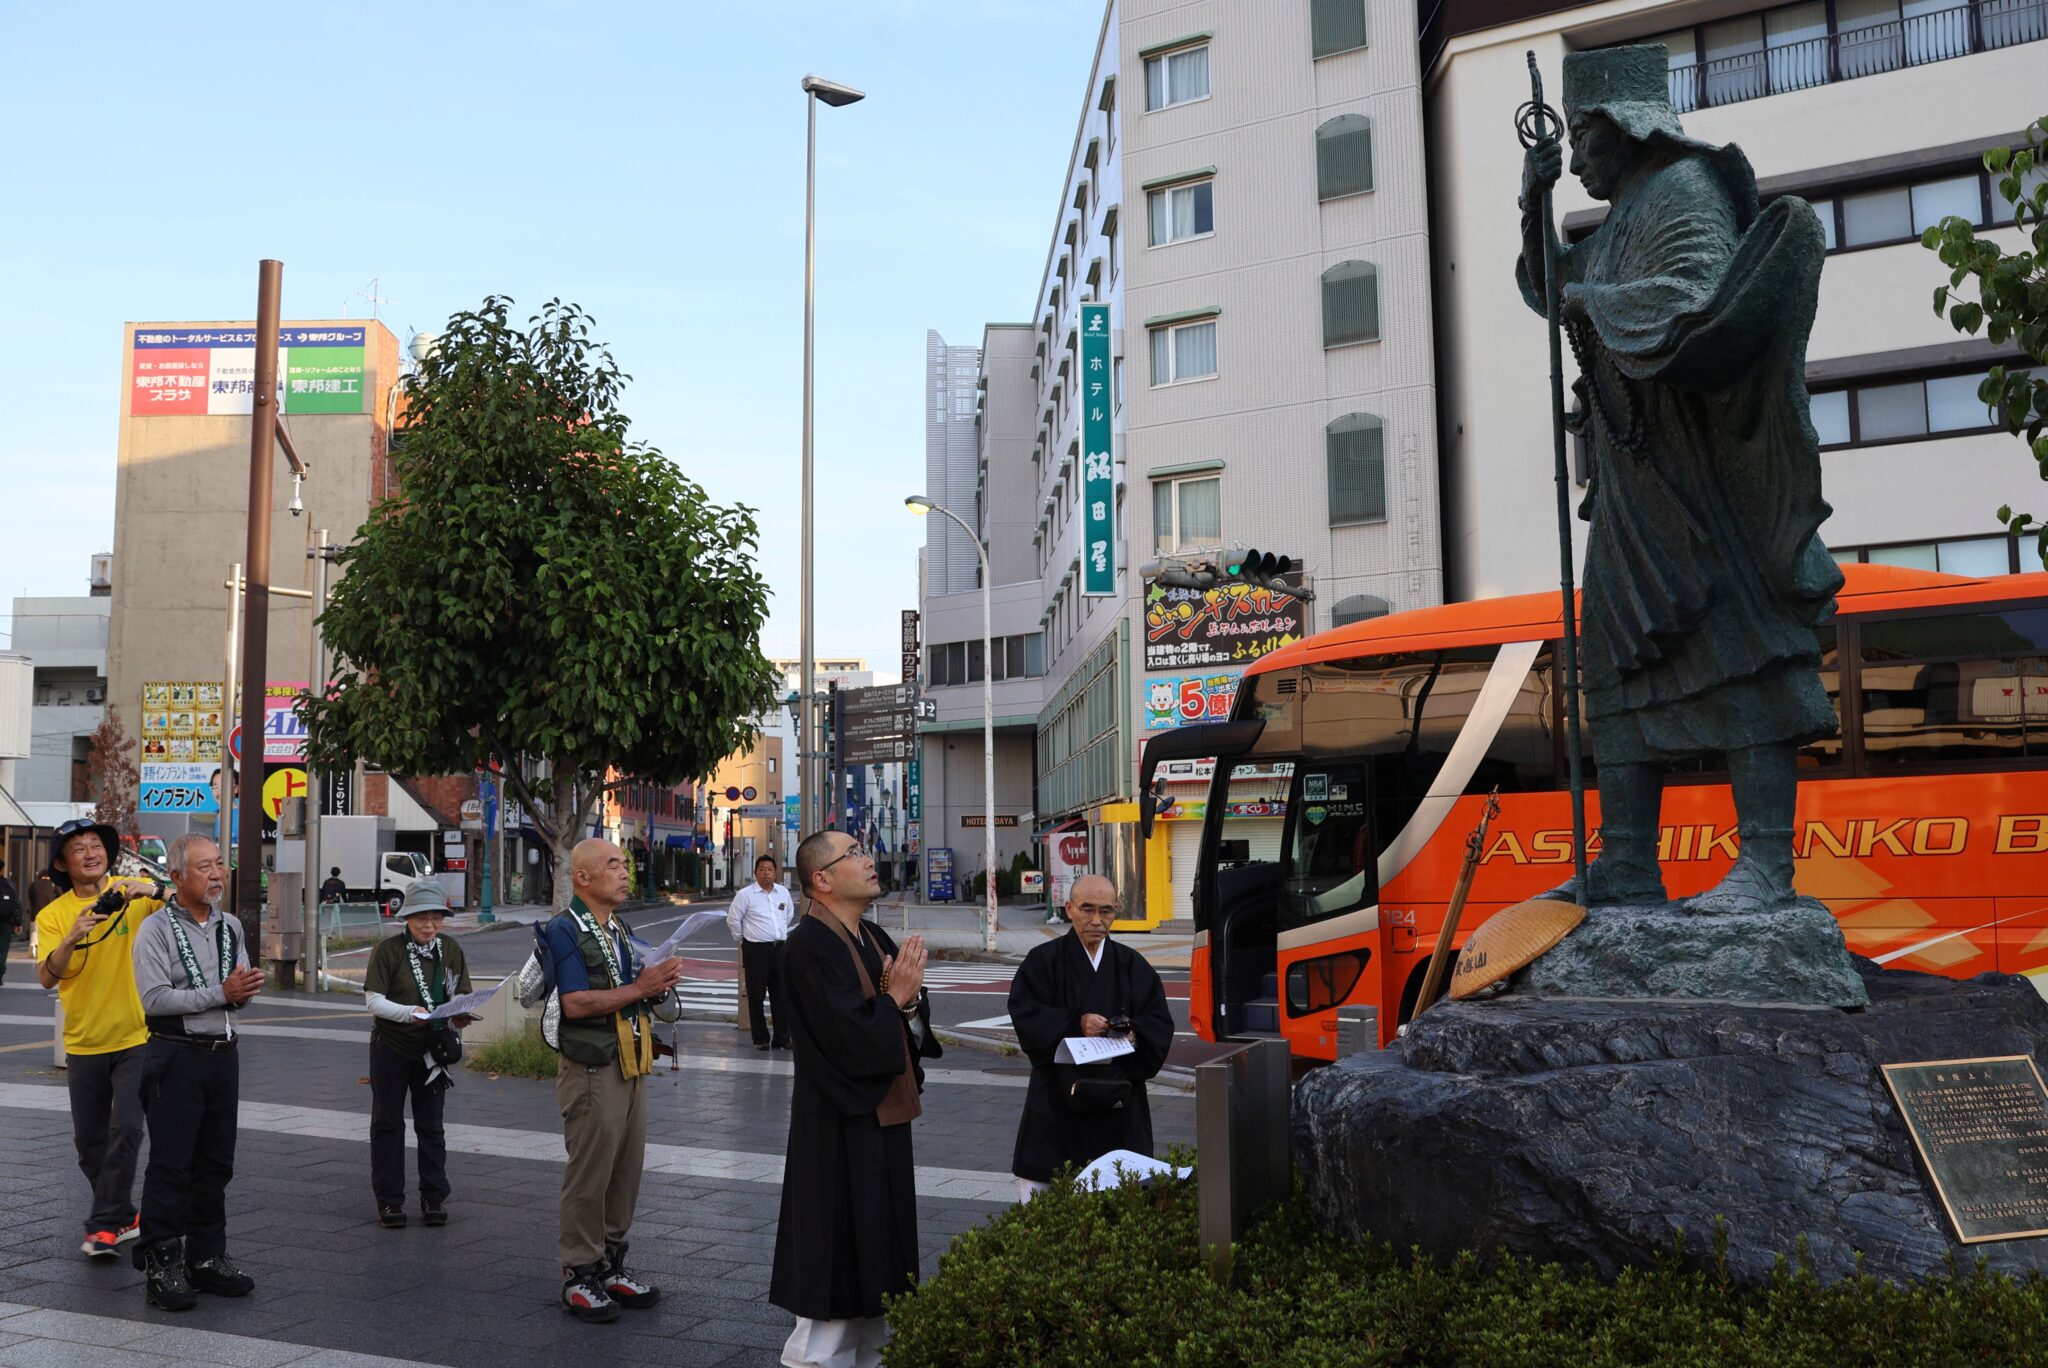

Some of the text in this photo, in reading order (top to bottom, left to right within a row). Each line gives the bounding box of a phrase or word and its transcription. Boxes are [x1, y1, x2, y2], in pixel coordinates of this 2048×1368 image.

[308, 332, 362, 342] 東邦グループ
[136, 375, 206, 388] 東邦不動産
[291, 379, 358, 393] 東邦建工
[1090, 356, 1103, 421] ホテル
[150, 389, 192, 401] プラザ
[1147, 579, 1296, 643] ジンギスカン
[143, 787, 205, 808] インプラント
[1479, 816, 1969, 866] ASIKNKO
[1384, 910, 1416, 925] 124
